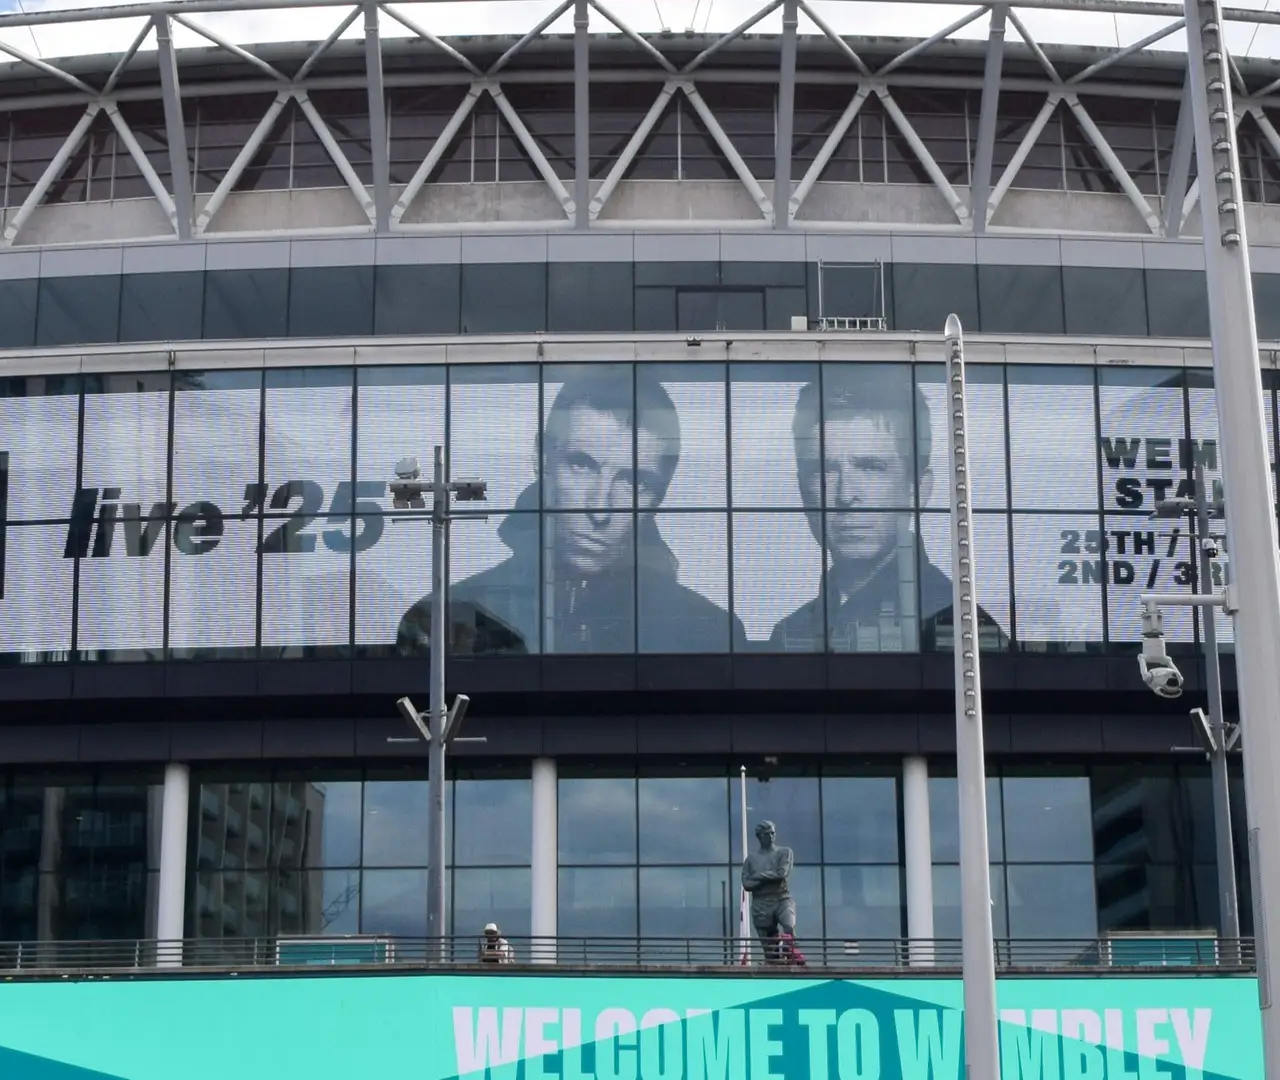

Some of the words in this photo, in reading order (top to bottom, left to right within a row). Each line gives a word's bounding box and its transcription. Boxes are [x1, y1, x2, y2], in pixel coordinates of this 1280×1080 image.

[63, 487, 225, 558] live
[241, 479, 387, 555] '25
[1060, 530, 1155, 555] 25TH
[1057, 560, 1135, 585] 2ND
[452, 1006, 785, 1080] WELCOME
[798, 1007, 880, 1080] TO
[893, 1007, 1212, 1080] WMBLEY
